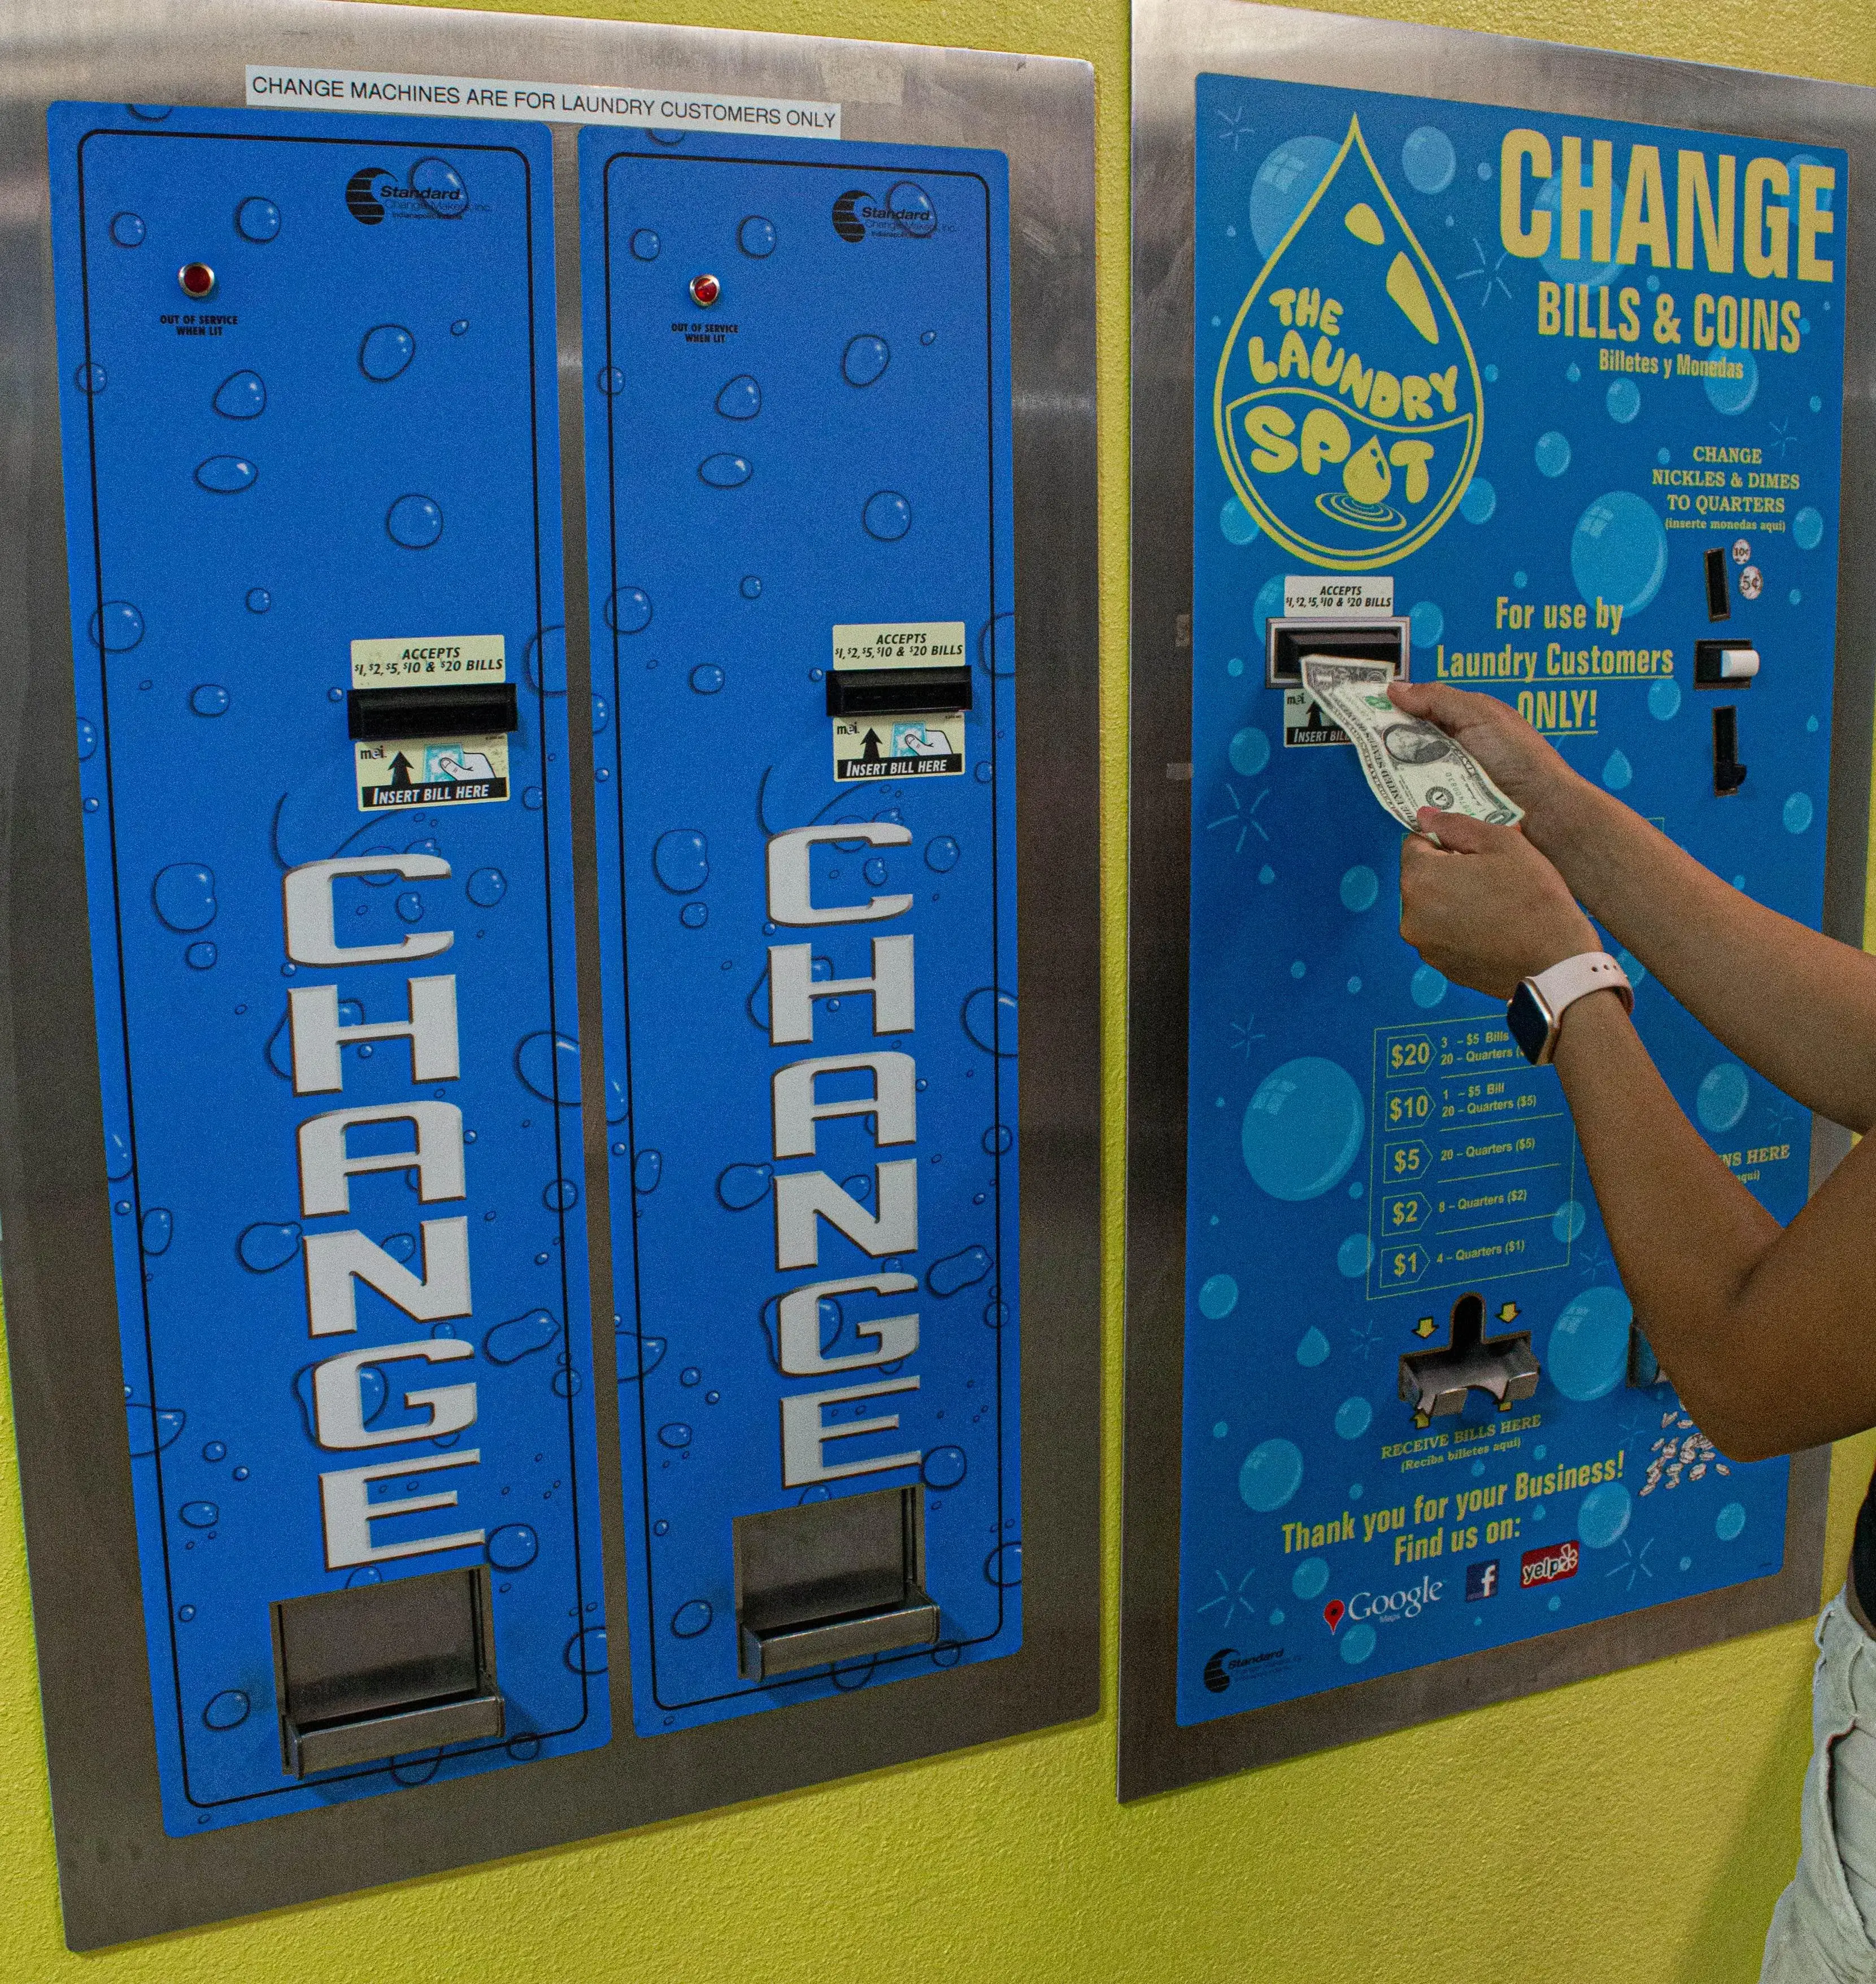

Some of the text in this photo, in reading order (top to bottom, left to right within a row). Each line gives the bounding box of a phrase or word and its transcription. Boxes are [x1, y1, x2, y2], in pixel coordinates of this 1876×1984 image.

[253, 76, 835, 129] CHANGE MACHINES ARE FOR LAUNDRY CUSTOMERS ONLY
[380, 185, 461, 200] Standard
[862, 207, 930, 221] Standard
[1500, 128, 1835, 283] CHANGE
[160, 315, 238, 325] OUT OF SERVICE
[1269, 287, 1344, 336] THE
[1538, 281, 1801, 353] BILLS & COINS
[176, 326, 223, 336] WHEN LIT
[671, 323, 739, 333] OUT OF SERVICE
[685, 334, 710, 343] WHEN
[1248, 329, 1457, 421] LAUNDRY
[1599, 348, 1744, 380] Billetes y Monedas
[1244, 405, 1434, 504] SPOT
[1692, 446, 1762, 464] CHANGE
[1652, 469, 1800, 490] NICKLES & DIMES
[1667, 494, 1785, 515] TO QUARTERS
[1710, 519, 1756, 530] monedas
[1320, 586, 1362, 595] ACCEPTS
[1742, 575, 1759, 591] 5¢
[1286, 597, 1391, 608] $1, $2, $5, $10 & $20 BILLS
[1496, 596, 1623, 636] For use by
[876, 633, 927, 645] ACCEPTS
[402, 647, 461, 660] ACCEPTS
[834, 644, 963, 660] $1, $2, $5, $10 & $20 BILLS
[1437, 642, 1674, 682] Laundry Customers
[354, 659, 503, 677] $1, $2, $5, $10 & $20 BILLS
[1517, 690, 1597, 729] ONLY!
[1294, 729, 1327, 742] INSERT
[1364, 732, 1385, 770] STATES
[846, 759, 947, 777] INSERT BILL HERE
[373, 784, 489, 805] INSERT BILL HERE
[1380, 769, 1405, 806] UNITED
[1441, 1037, 1448, 1048] 3
[1466, 1033, 1479, 1045] $5
[1486, 1031, 1509, 1043] Bills
[1391, 1042, 1430, 1069] $20
[1440, 1053, 1453, 1065] 20
[1466, 1048, 1512, 1063] Quarters
[1443, 1089, 1448, 1100] 1
[1468, 1085, 1481, 1098] $5
[1487, 1082, 1505, 1094] Bill
[1390, 1095, 1428, 1122] $10
[1442, 1105, 1454, 1117] 20
[1467, 1098, 1513, 1114] Quarters
[765, 822, 922, 1489] CHANGE
[1394, 1148, 1420, 1174] $5
[1440, 1149, 1453, 1161] 20
[1466, 1141, 1512, 1158] Quarters
[1746, 1144, 1790, 1164] HERE
[282, 853, 486, 1573] CHANGE
[1393, 1200, 1417, 1226] $2
[1439, 1202, 1445, 1213] 8
[1458, 1194, 1504, 1210] Quarters
[1507, 1189, 1526, 1204] ($2)
[1437, 1252, 1443, 1264] 4
[1456, 1245, 1502, 1261] Quarters
[1505, 1240, 1525, 1255] ($1)
[1394, 1252, 1417, 1277] $1
[1381, 1415, 1541, 1459] RECEIVE BILLS HERE
[1400, 1455, 1444, 1473] (Reciba
[1448, 1446, 1490, 1461] billetes
[1282, 1450, 1625, 1554] Thank you for your Business!
[1394, 1516, 1521, 1565] Find us on:
[1524, 1556, 1562, 1585] yelp
[1348, 1574, 1443, 1618] Google
